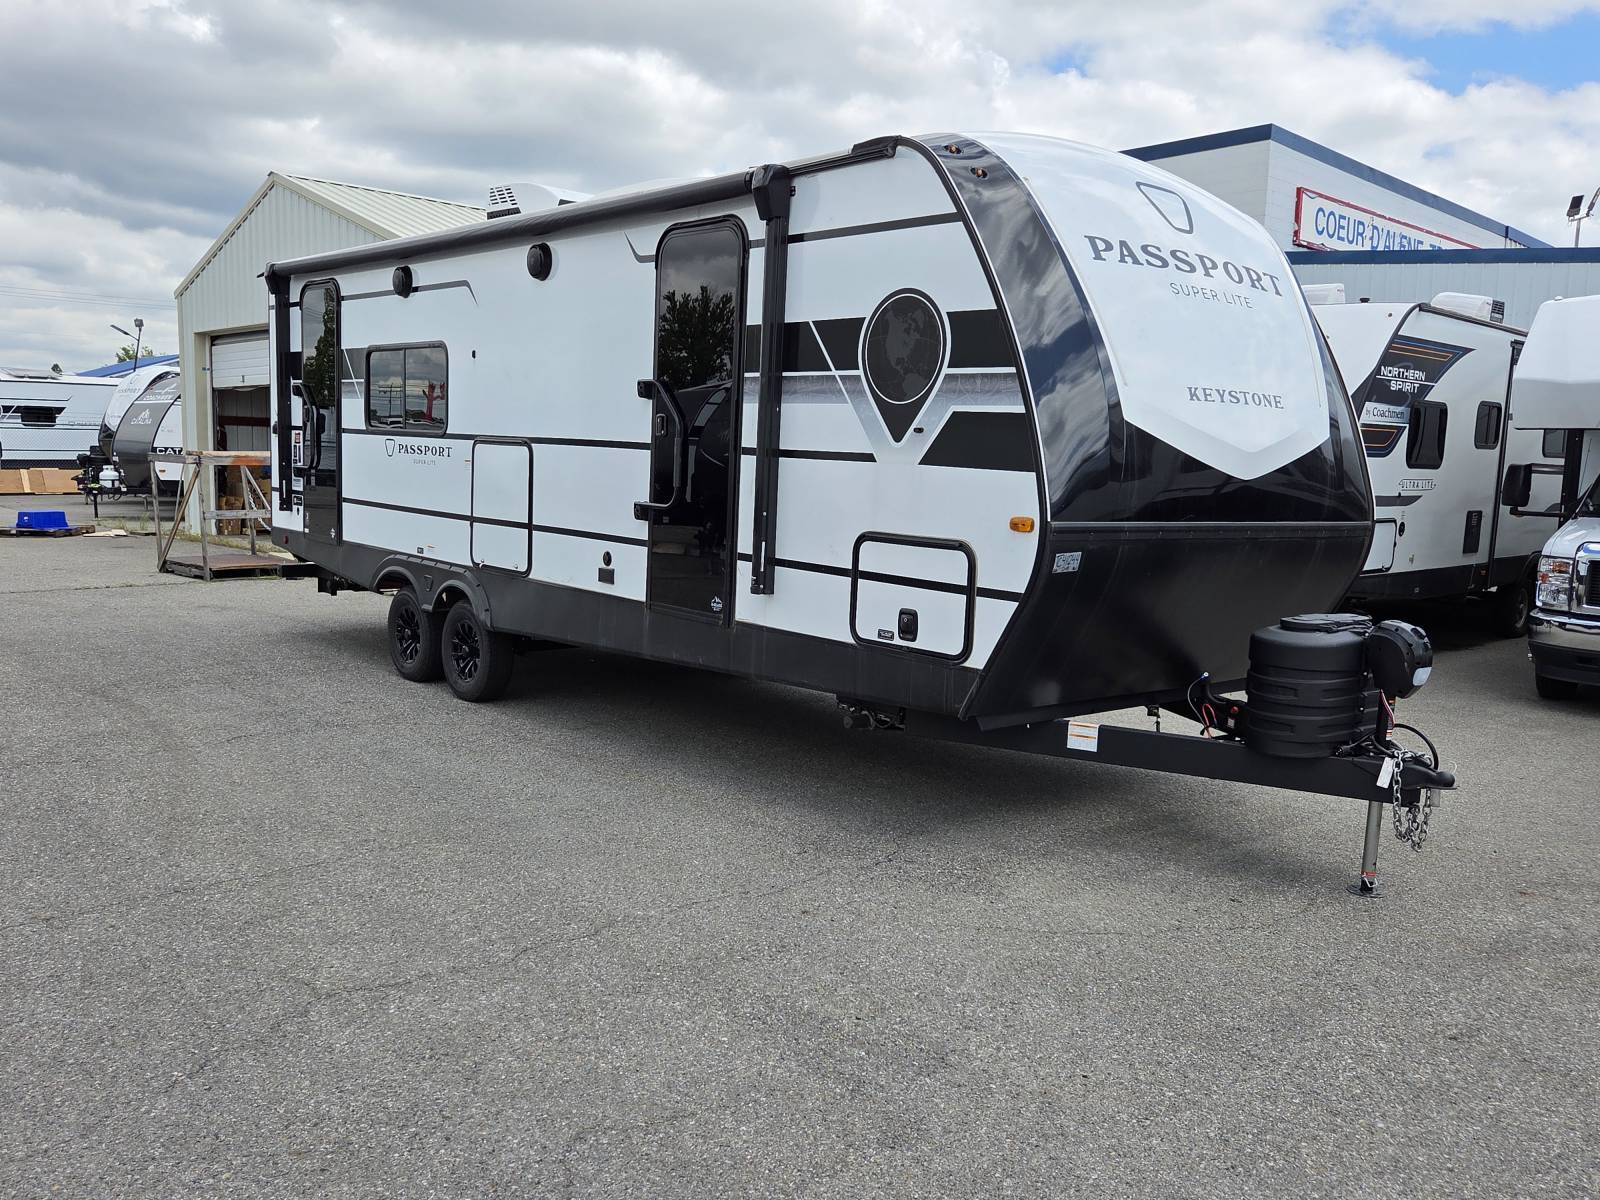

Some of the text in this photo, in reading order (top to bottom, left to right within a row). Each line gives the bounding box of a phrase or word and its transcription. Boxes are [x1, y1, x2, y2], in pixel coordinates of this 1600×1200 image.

[1314, 207, 1366, 248] COEUR
[1084, 235, 1283, 297] PASSPORT
[1169, 282, 1254, 309] SUPER LITE
[1380, 365, 1426, 381] NORTHERN
[1390, 380, 1420, 393] SPIRIT
[1186, 386, 1284, 409] KEYSTONE
[1365, 407, 1405, 419] by Coachmen
[398, 444, 452, 457] PASSPORT
